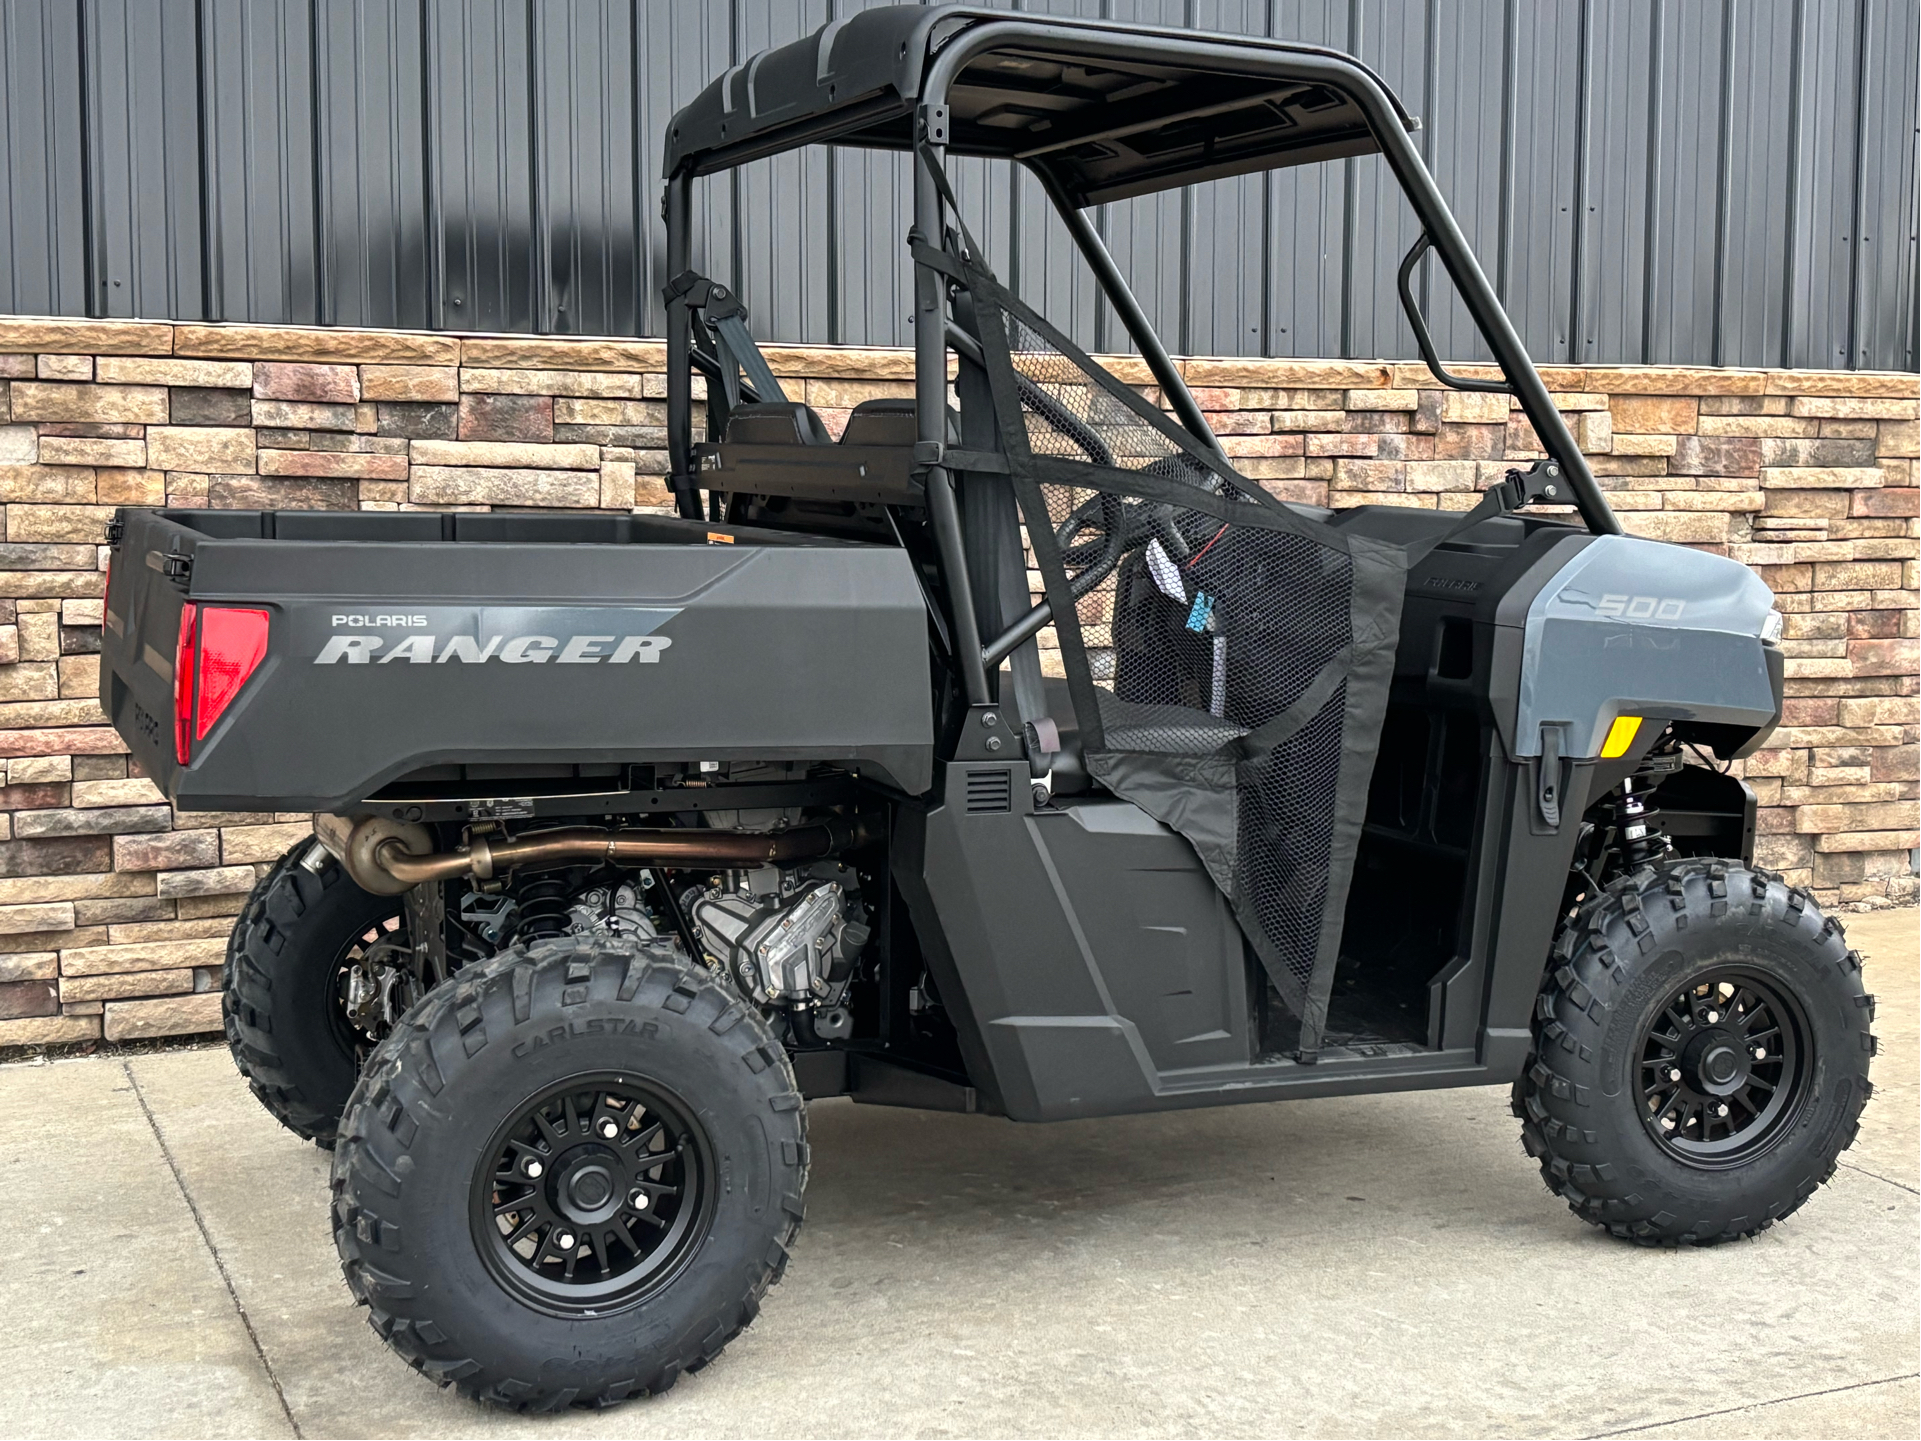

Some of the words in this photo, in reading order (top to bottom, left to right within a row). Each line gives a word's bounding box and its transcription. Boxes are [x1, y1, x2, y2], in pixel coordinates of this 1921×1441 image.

[331, 614, 428, 627] POLARIS
[1595, 594, 1686, 620] 500
[313, 635, 672, 664] RANGER
[511, 1017, 662, 1059] CARLSTAR
